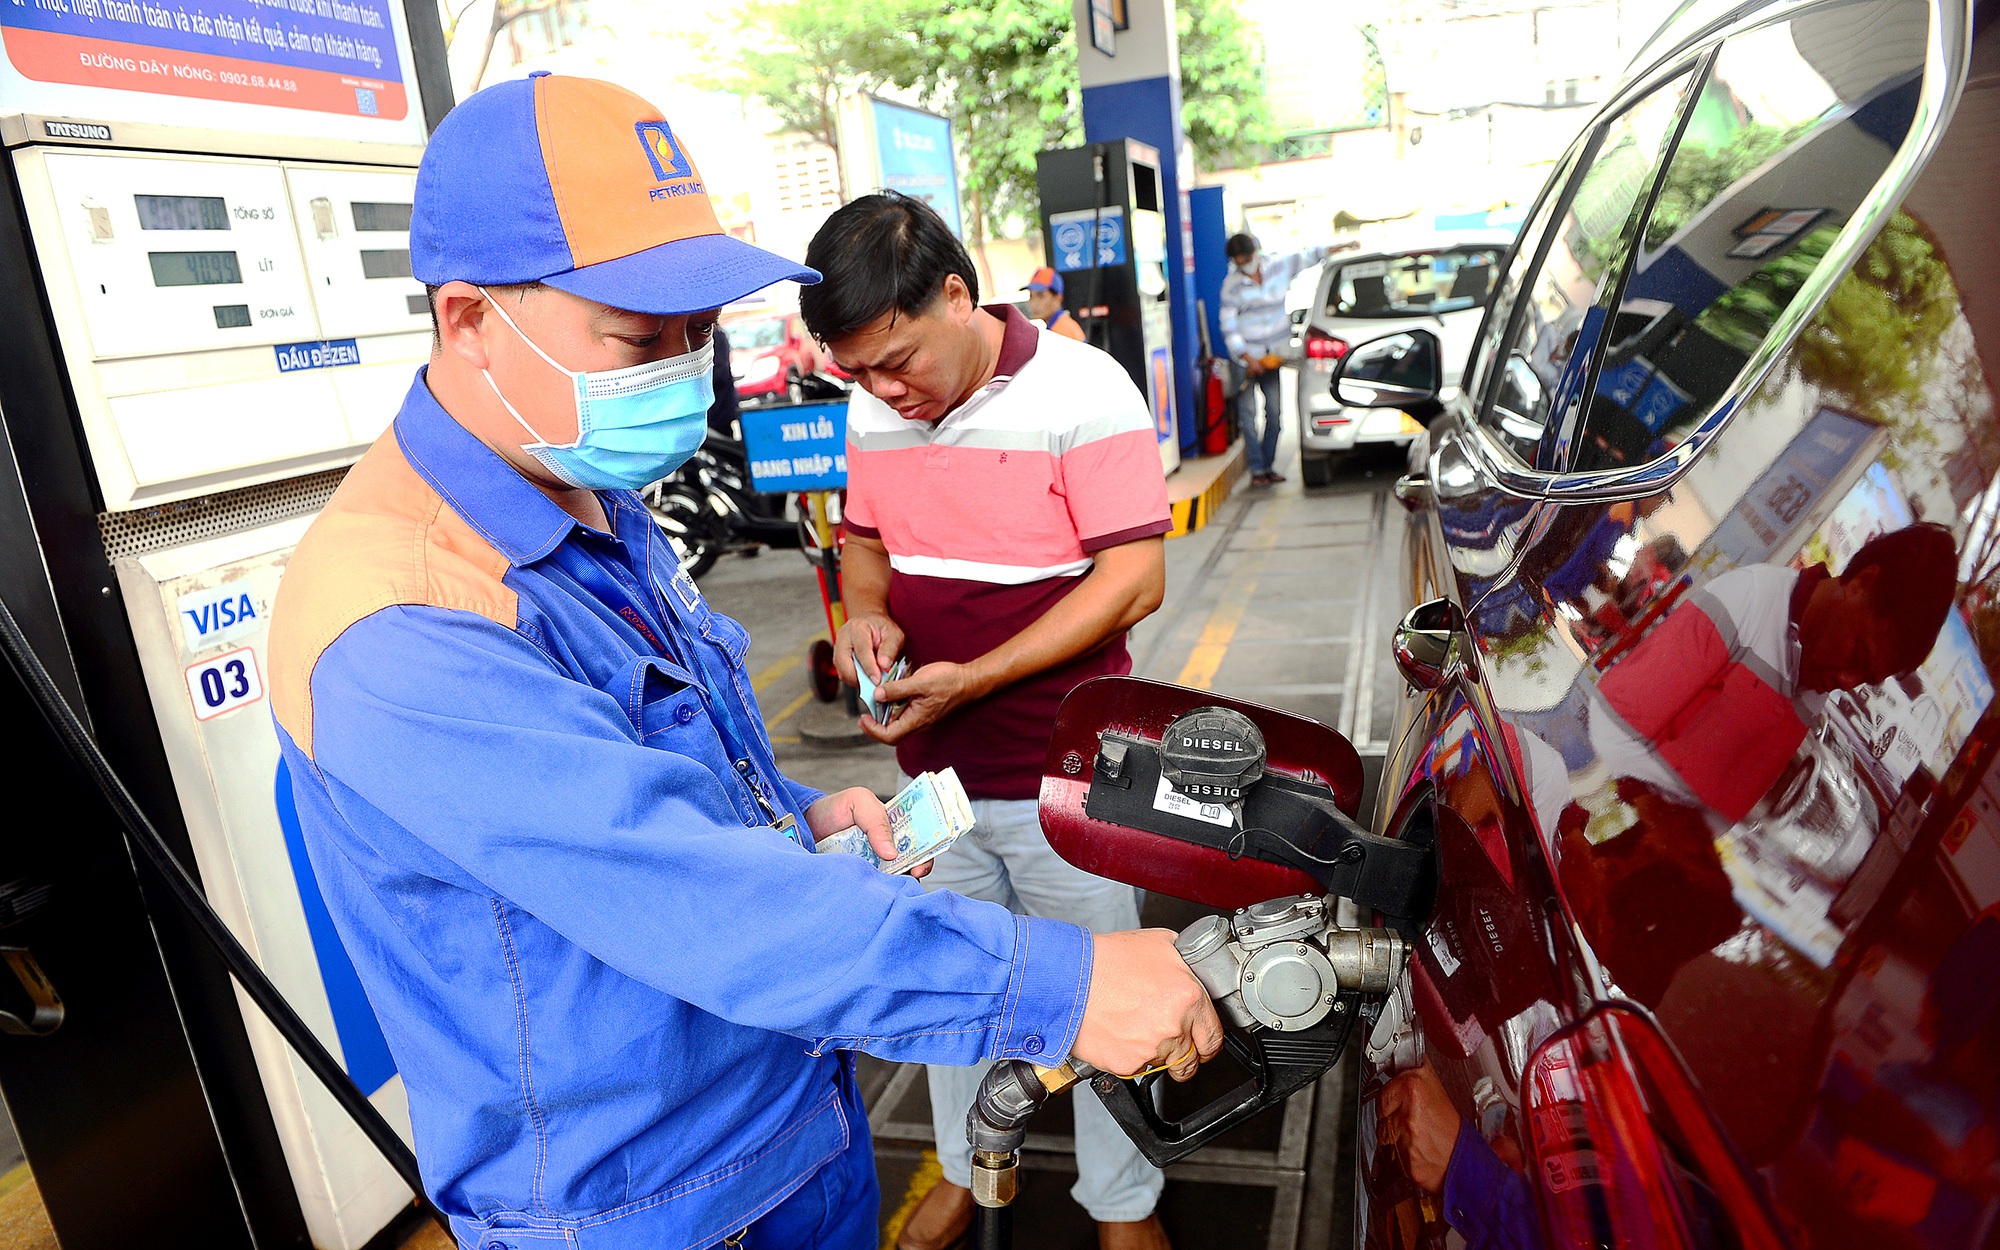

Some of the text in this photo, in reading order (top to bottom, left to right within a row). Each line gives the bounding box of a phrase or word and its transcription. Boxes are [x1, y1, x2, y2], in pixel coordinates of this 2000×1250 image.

[102, 0, 143, 25] thanh
[142, 1, 174, 29] toán
[172, 6, 191, 32] và
[189, 9, 214, 37] xác
[213, 13, 245, 46] nhận
[242, 16, 265, 45] kết
[263, 21, 290, 52] quả,
[288, 24, 312, 53] cảm
[311, 33, 327, 55] ơn
[324, 32, 357, 60] khách
[80, 52, 298, 92] ĐƯỜNG DÂY NÓNG: 0902.68.44.88
[46, 122, 109, 139] TATSUNO
[258, 257, 274, 272] LÍT
[781, 422, 809, 442] XIN
[792, 453, 834, 478] NHẬP
[182, 593, 256, 635] VISA
[200, 659, 250, 708] 03
[1183, 737, 1243, 752] DIESEL
[1164, 793, 1191, 806] DIESEL
